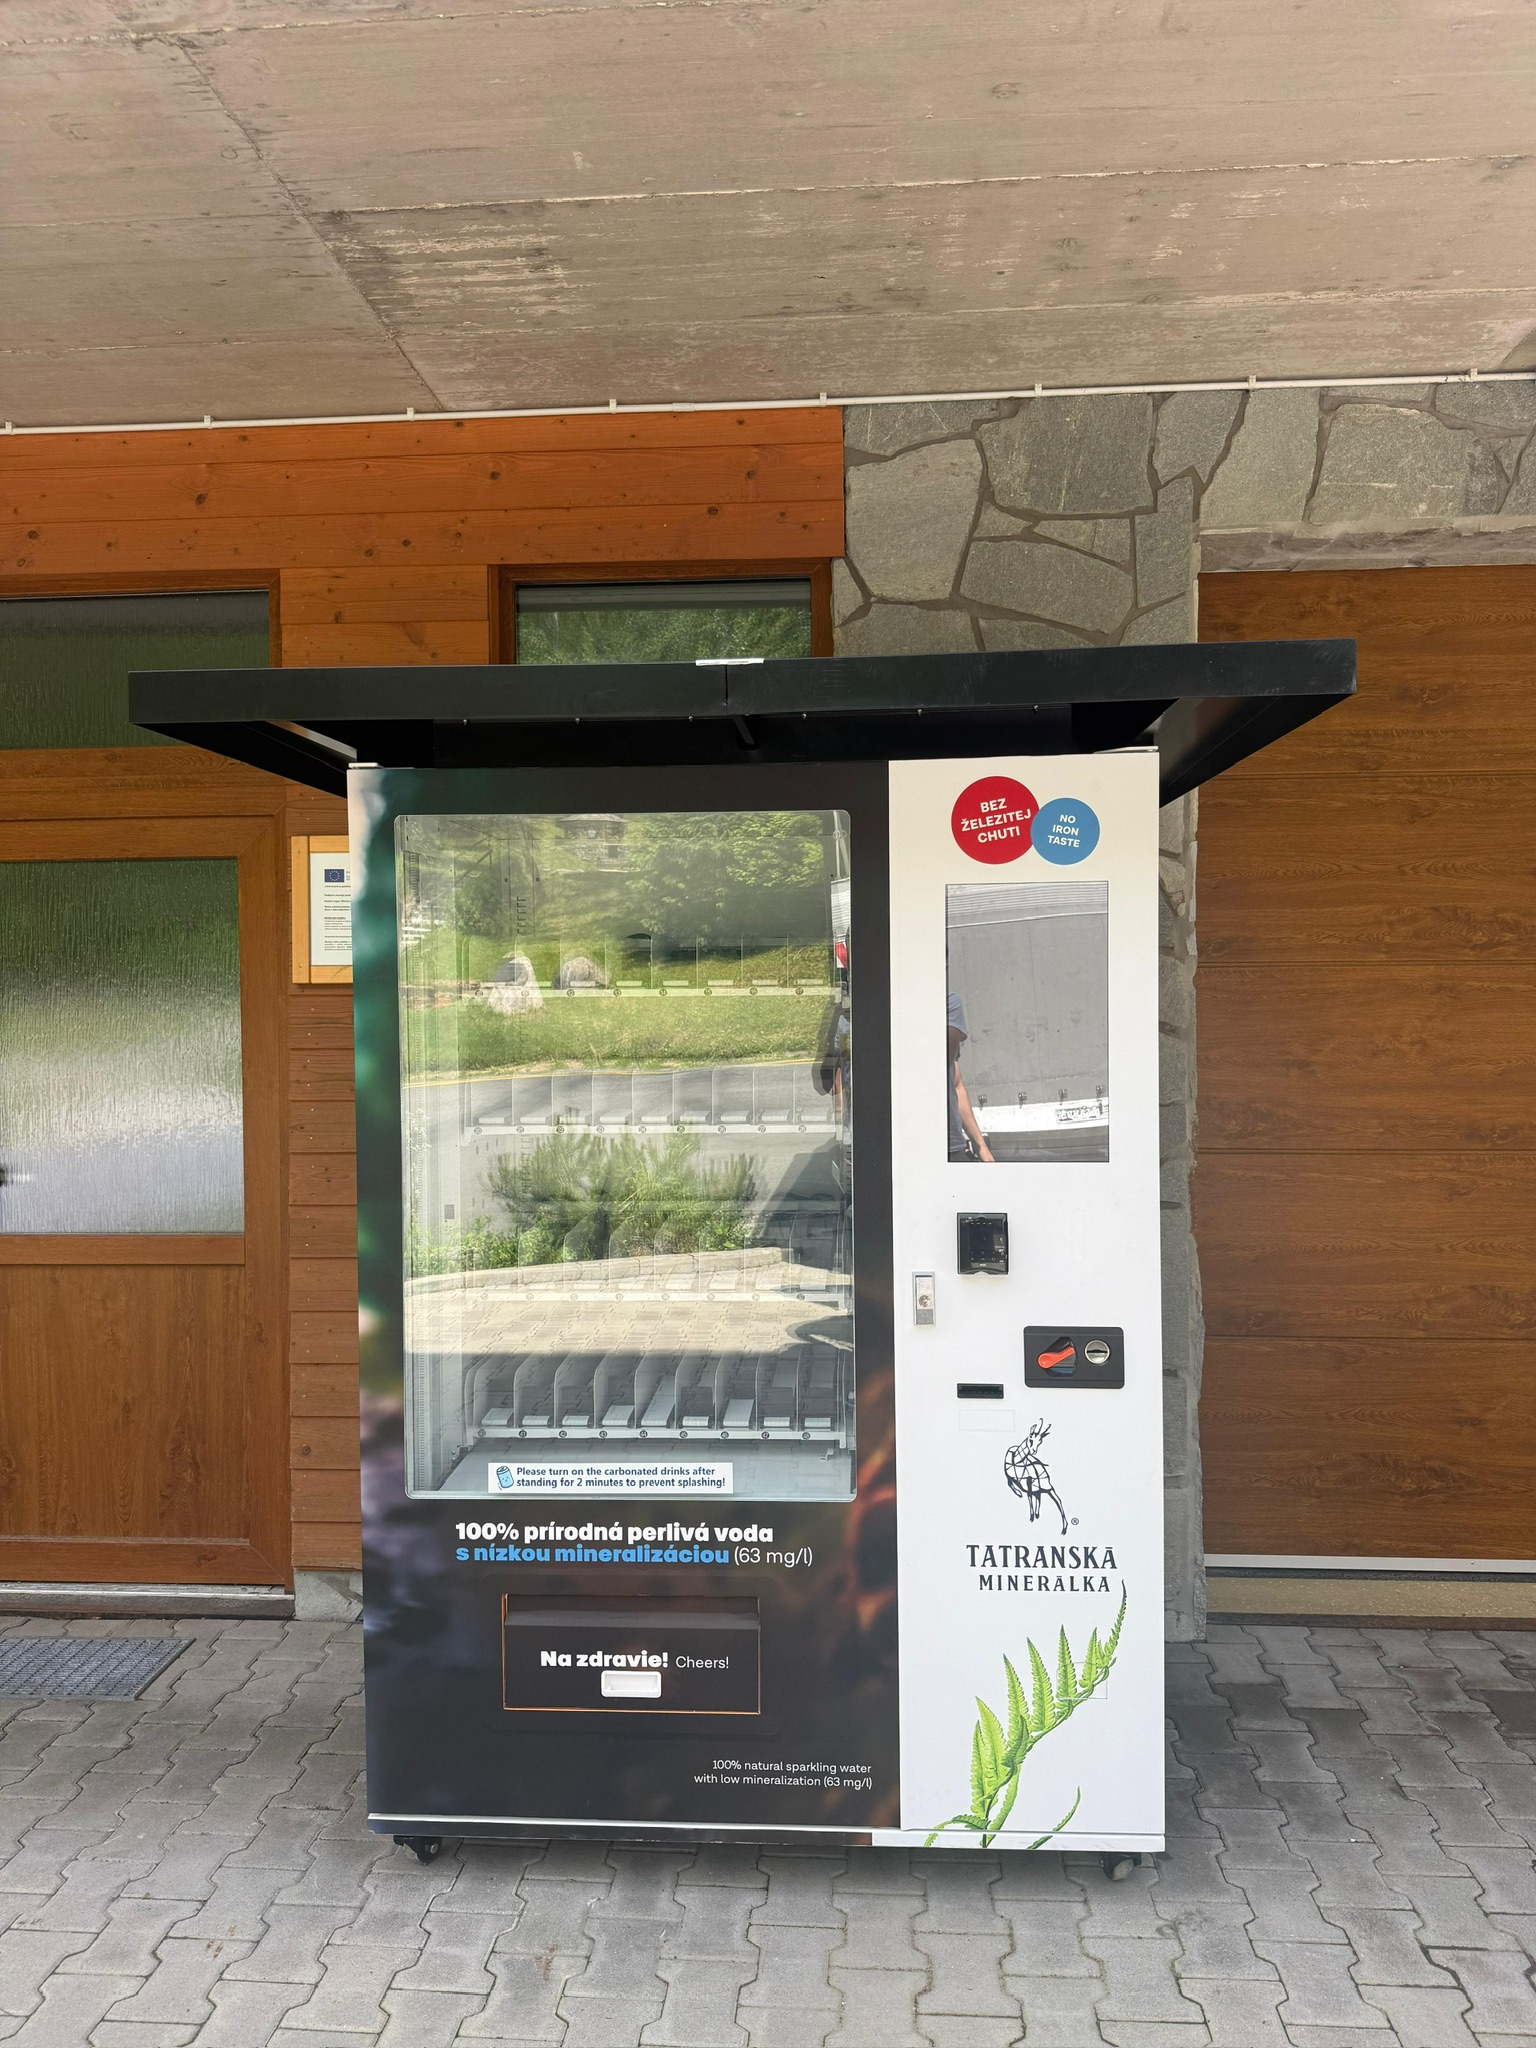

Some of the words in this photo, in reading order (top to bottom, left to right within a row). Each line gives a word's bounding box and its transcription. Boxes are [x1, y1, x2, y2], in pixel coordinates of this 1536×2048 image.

[980, 797, 1007, 813] BEZ
[960, 808, 1032, 832] ŽELEZITEJ
[1059, 814, 1076, 824] NO
[977, 825, 1021, 844] CHUTI
[1052, 824, 1079, 836] IRON
[1047, 835, 1080, 848] TASTE
[516, 1467, 547, 1476] Please
[548, 1467, 569, 1476] turn
[586, 1466, 602, 1476] the
[604, 1466, 658, 1476] carbonated
[660, 1466, 690, 1476] drinks
[692, 1466, 715, 1476] after
[516, 1477, 557, 1489] standing
[560, 1477, 574, 1487] for
[577, 1477, 583, 1487] 2
[585, 1477, 624, 1487] minutes
[625, 1478, 636, 1487] to
[638, 1478, 675, 1489] prevent
[677, 1477, 725, 1489] splashing!
[456, 1522, 520, 1540] 100%
[524, 1521, 623, 1544] prírodná
[627, 1522, 710, 1545] perlivá
[714, 1524, 774, 1543] voda
[456, 1547, 470, 1561] s
[474, 1543, 550, 1562] nízkou
[555, 1543, 729, 1563] mineralizáciou
[734, 1546, 761, 1566] (63
[766, 1547, 813, 1568] mg/l)
[540, 1650, 572, 1667] Na
[576, 1650, 669, 1668] zdravie!
[675, 1655, 729, 1669] Cheers!
[712, 1759, 742, 1770] 100%
[744, 1761, 784, 1771] natural
[786, 1761, 837, 1775] sparkling
[839, 1763, 872, 1774] water
[694, 1773, 718, 1784] with
[720, 1774, 740, 1784] low
[742, 1775, 821, 1786] mineralization
[823, 1776, 841, 1788] (63
[843, 1777, 873, 1791] mg/l)
